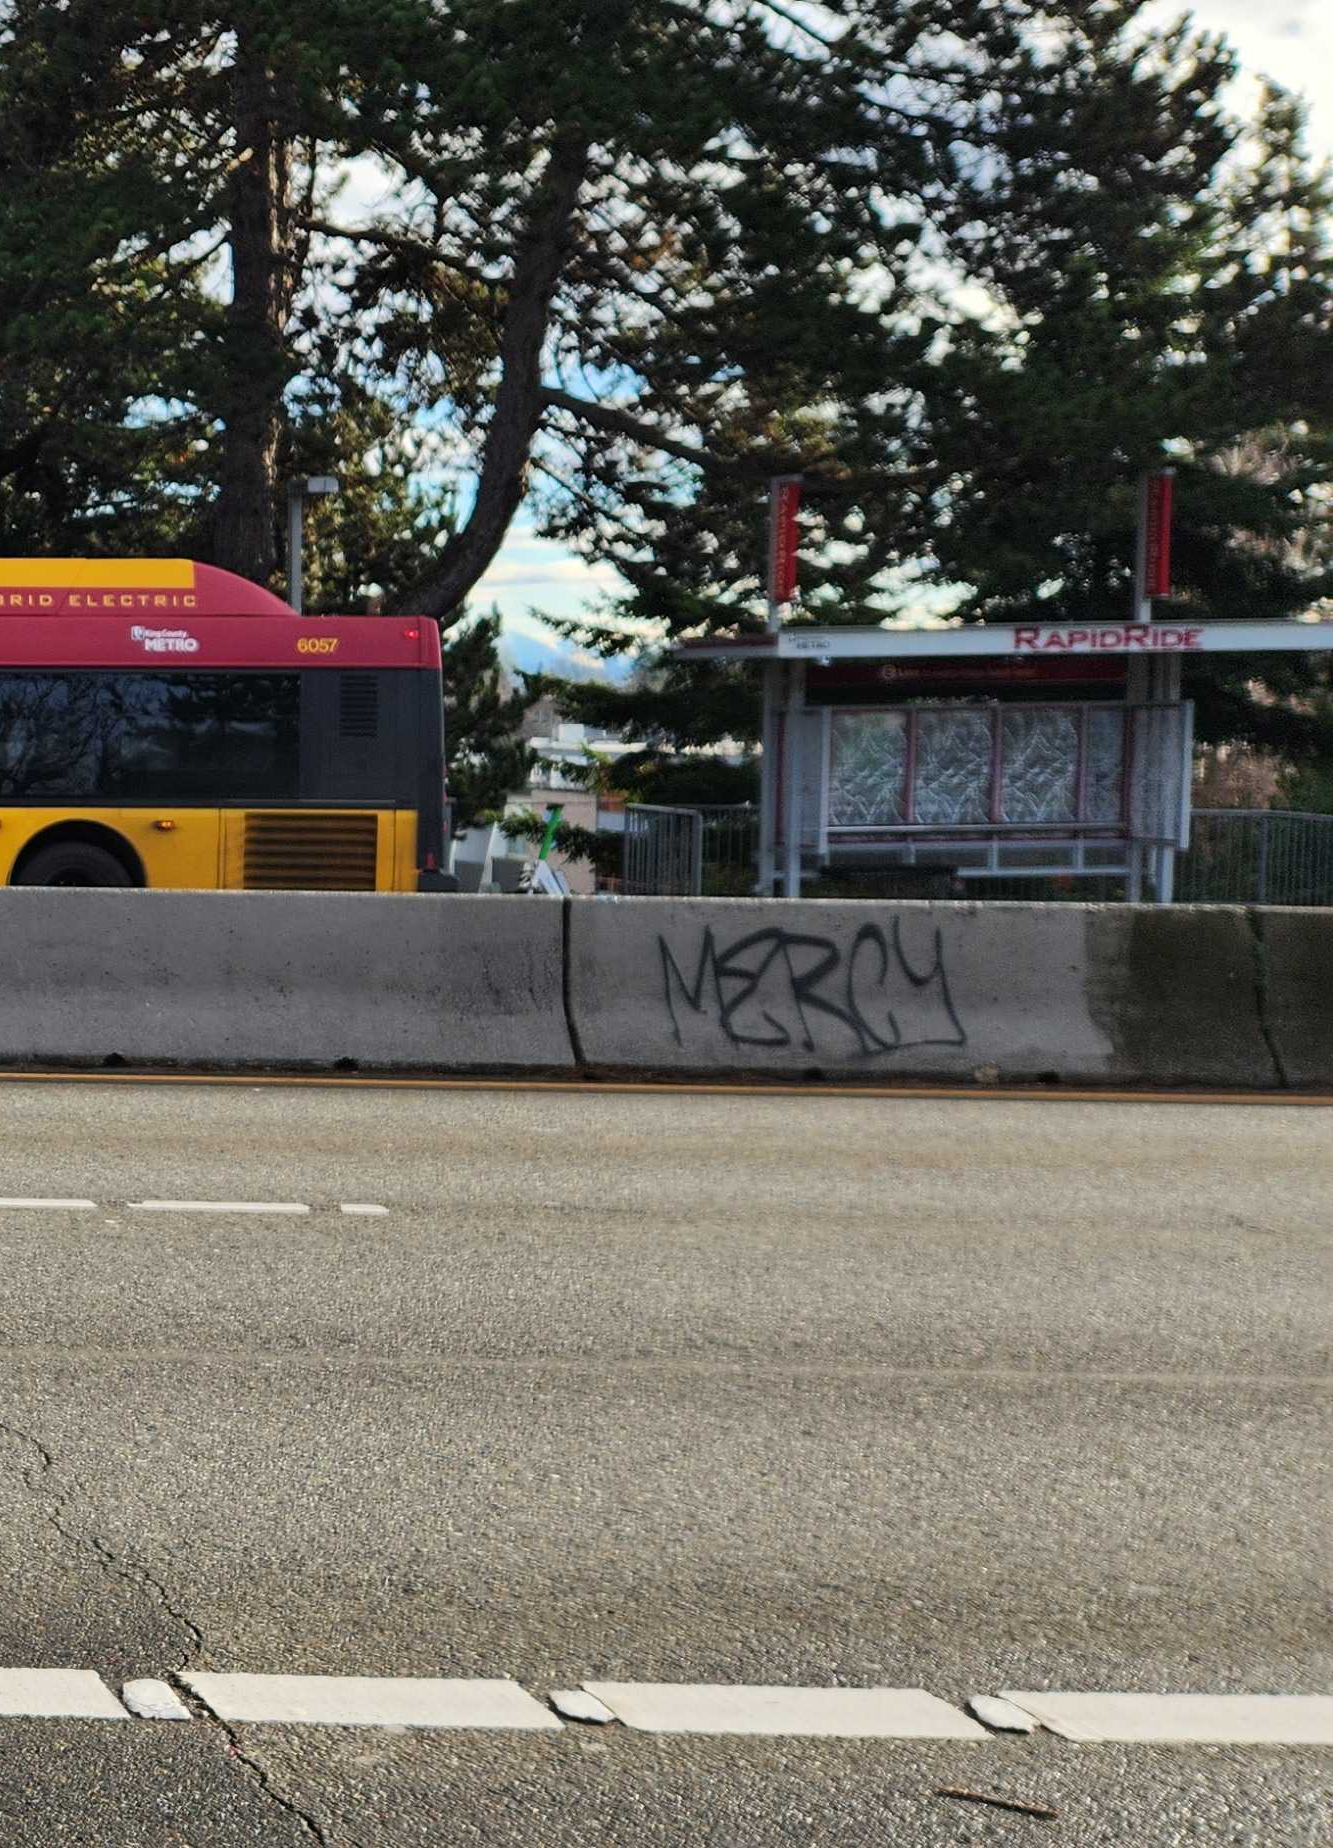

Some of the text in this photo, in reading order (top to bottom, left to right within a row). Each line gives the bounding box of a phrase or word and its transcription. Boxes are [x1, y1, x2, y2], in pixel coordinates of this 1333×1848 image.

[68, 594, 197, 607] ELECTRIC
[144, 638, 199, 652] METRO
[296, 638, 339, 653] 6057
[658, 914, 967, 1057] MERCY
